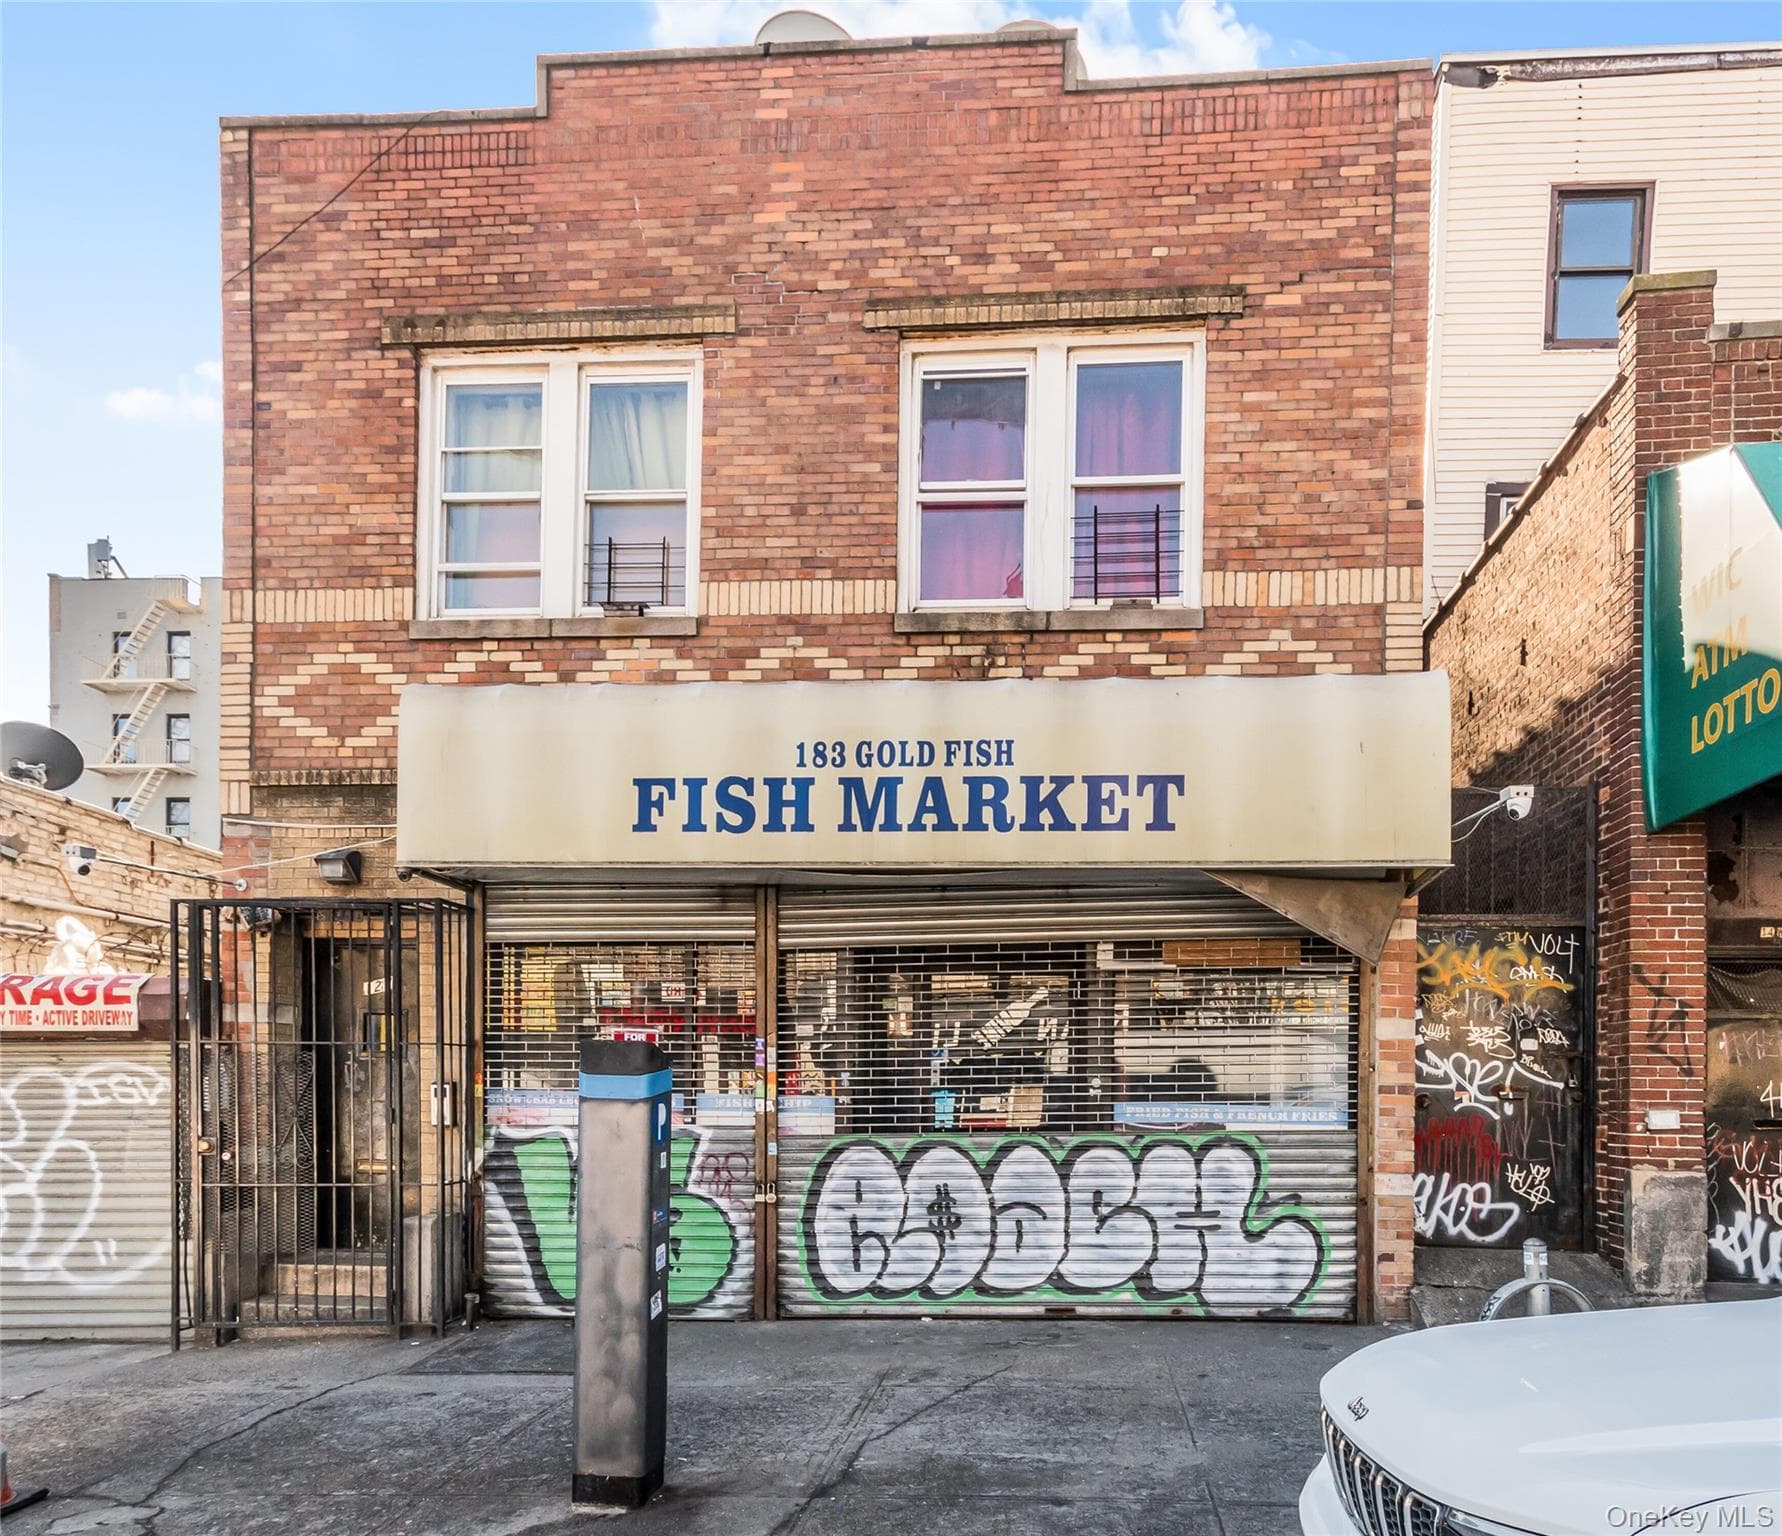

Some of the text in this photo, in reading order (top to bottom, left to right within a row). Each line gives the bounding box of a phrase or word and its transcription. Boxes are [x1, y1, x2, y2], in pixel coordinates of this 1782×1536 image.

[1691, 615, 1748, 689] ATM
[1691, 668, 1781, 754] LOTTO
[796, 739, 1015, 768] 183 GOLD FISH
[632, 774, 1185, 833] FISH MARKET
[0, 975, 142, 1006] RAGE
[9, 1010, 33, 1025] TIME
[43, 1010, 79, 1025] ACTIVE
[81, 1010, 133, 1025] DRIVEWAY
[623, 1032, 646, 1042] FOR
[1126, 1106, 1170, 1118] FRIED
